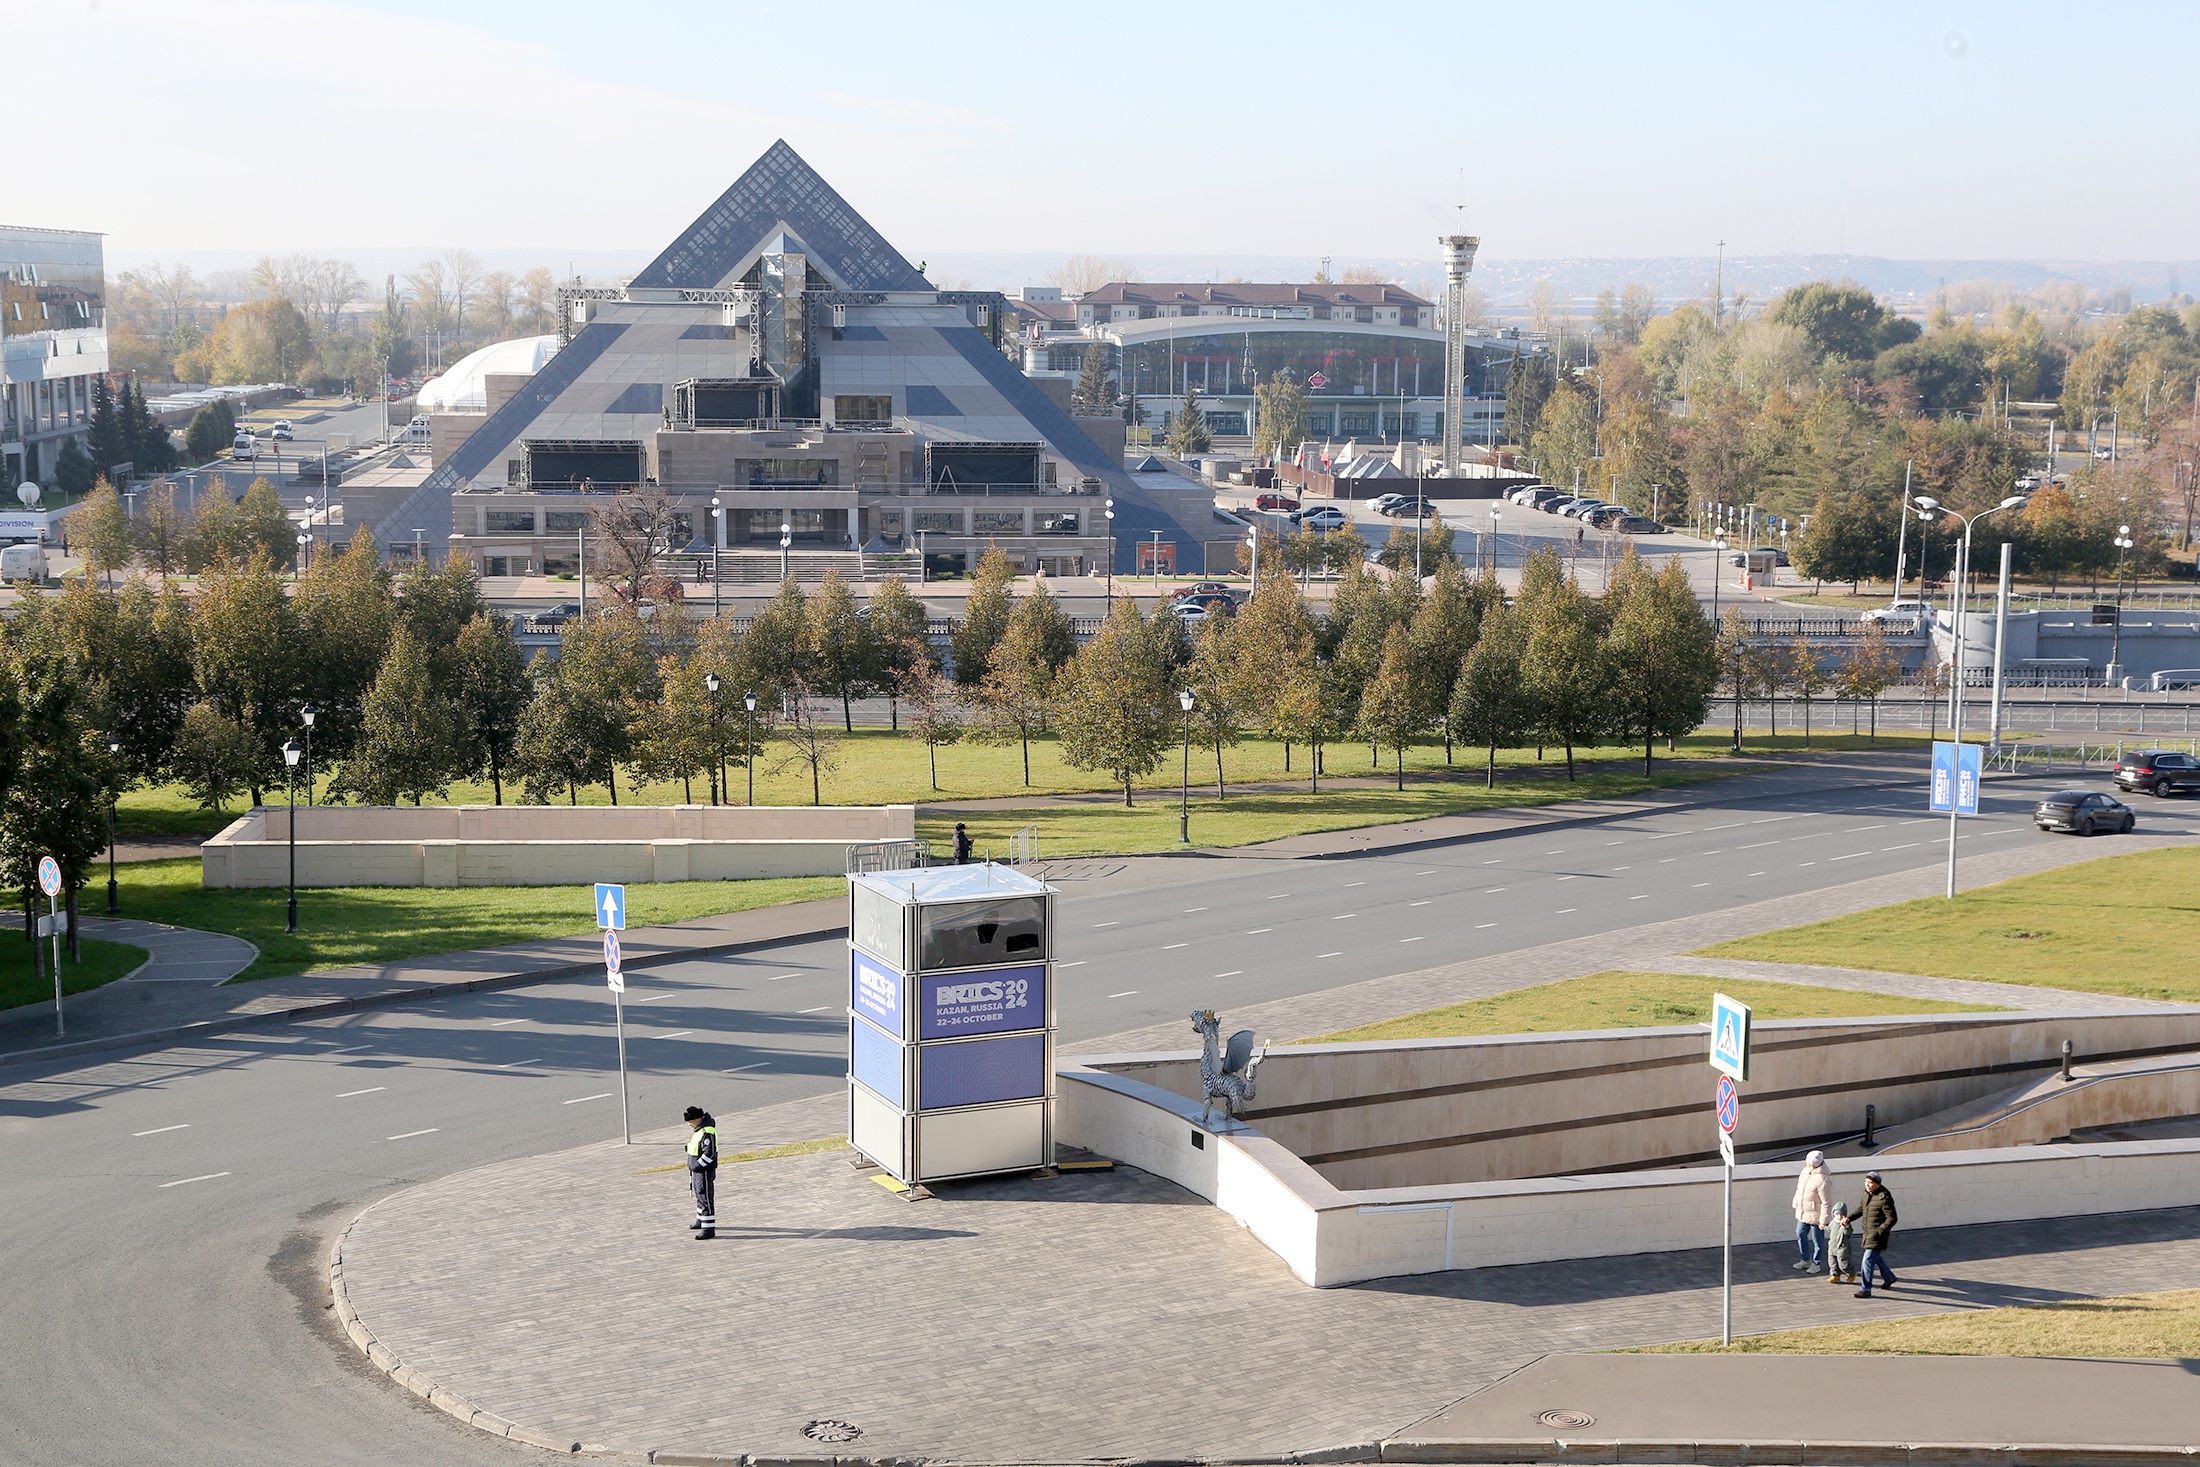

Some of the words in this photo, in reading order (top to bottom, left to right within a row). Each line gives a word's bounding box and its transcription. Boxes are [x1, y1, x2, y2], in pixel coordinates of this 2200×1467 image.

[860, 963, 887, 996] BRICS
[937, 981, 1004, 1006] BRICS
[1005, 979, 1028, 995] 20
[1005, 994, 1028, 1009] 24
[937, 1005, 970, 1016] KAZAN,
[970, 1003, 1004, 1013] RUSSIA
[963, 1013, 1004, 1023] OCTOBER
